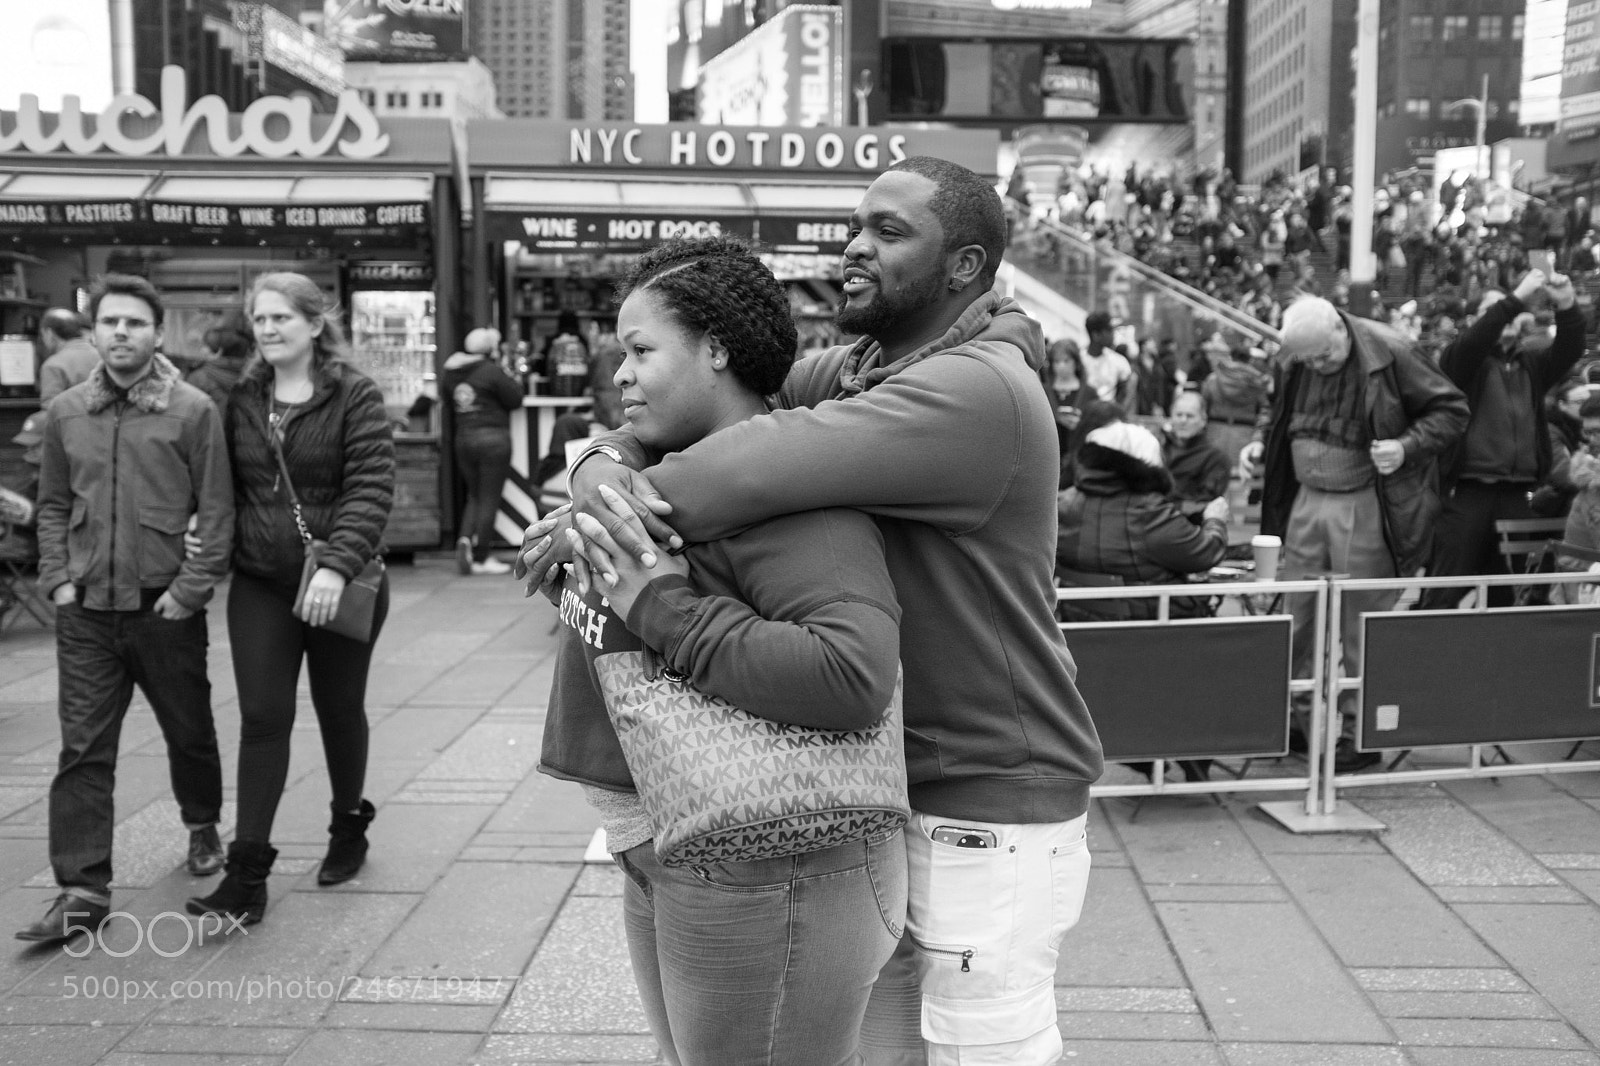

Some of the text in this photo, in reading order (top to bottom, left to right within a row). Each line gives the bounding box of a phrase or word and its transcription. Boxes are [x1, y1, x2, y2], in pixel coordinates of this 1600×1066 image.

[0, 65, 391, 158] uchas
[569, 128, 907, 169] NYC HOTDOGS
[65, 203, 134, 223] PASTRIES
[152, 204, 193, 224] DRAFT
[195, 206, 229, 225] BEER
[238, 207, 275, 227] WINE
[285, 207, 317, 226] ICED
[318, 207, 367, 226] DRINKS
[376, 204, 425, 225] COFFEE
[522, 218, 722, 241] WINE HOT DOGS
[797, 223, 849, 242] BEER
[615, 672, 647, 690] MK
[634, 684, 666, 704] MK
[654, 697, 687, 715] MK
[689, 695, 722, 709] MK
[642, 718, 673, 742] MK
[674, 712, 708, 731] MK
[709, 708, 743, 726] MK
[660, 732, 693, 757] MK
[695, 727, 729, 747] MK
[730, 722, 764, 741] MK
[652, 757, 680, 785] MK
[680, 748, 714, 772] MK
[715, 741, 751, 762] MK
[751, 738, 786, 755] MK
[786, 735, 820, 750] MK
[820, 732, 854, 746] MK
[854, 731, 886, 746] MK
[669, 772, 700, 800] MK
[700, 764, 736, 788] MK
[737, 756, 772, 779] MK
[773, 751, 807, 772] MK
[808, 749, 841, 767] MK
[841, 748, 875, 766] MK
[874, 749, 900, 769] MK
[688, 789, 721, 815] MK
[722, 780, 757, 804] MK
[758, 773, 793, 797] MK
[793, 770, 827, 790] MK
[828, 768, 861, 787] MK
[862, 768, 892, 788] MK
[708, 805, 743, 831] MK
[744, 799, 781, 822] MK
[780, 795, 812, 816] MK
[814, 790, 847, 811] MK
[705, 835, 738, 848] MK
[742, 831, 776, 847] MK
[778, 828, 810, 843] MK
[814, 821, 846, 838] MK
[849, 813, 880, 831] MK
[685, 848, 718, 858] MK
[721, 847, 755, 857] MK
